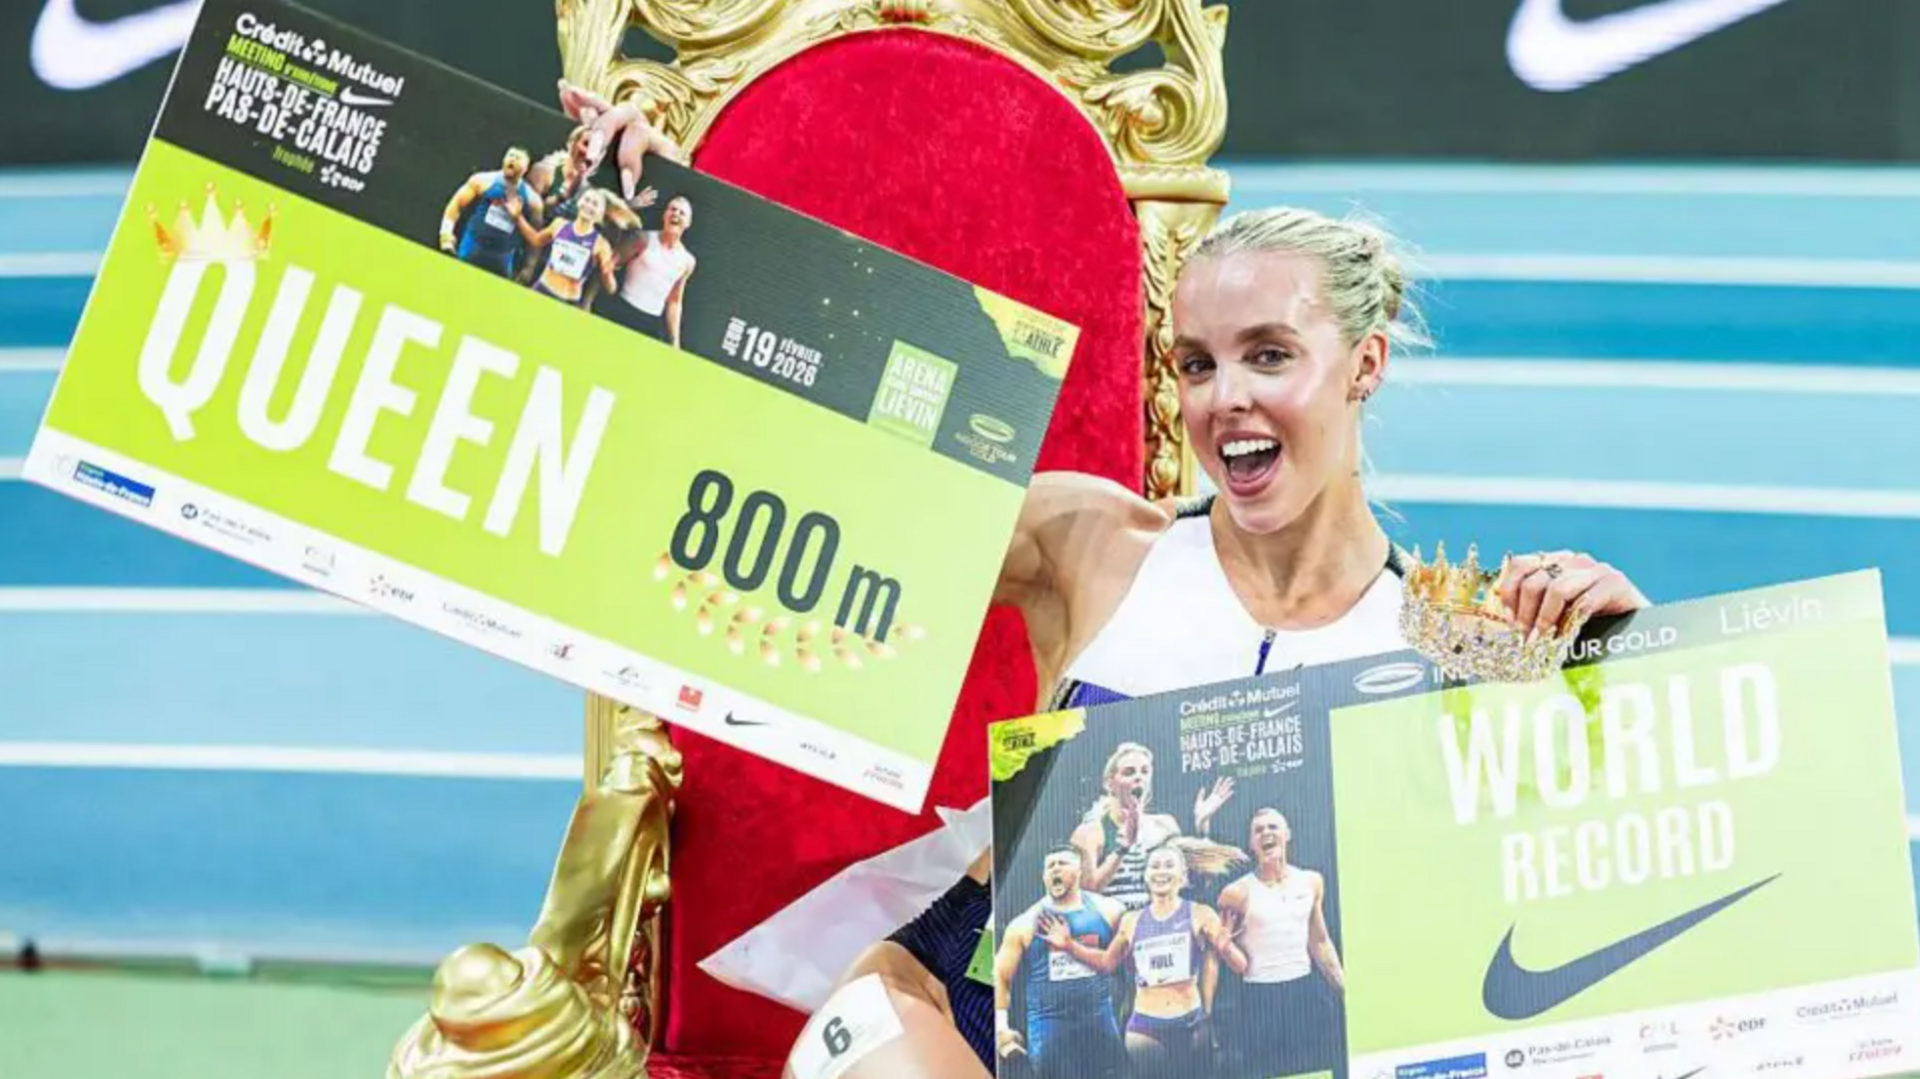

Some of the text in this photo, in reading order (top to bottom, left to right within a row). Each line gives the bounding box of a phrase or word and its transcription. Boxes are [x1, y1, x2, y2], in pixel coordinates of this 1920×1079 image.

[226, 33, 287, 72] MEETING
[236, 13, 305, 58] Crédit
[327, 49, 404, 97] Mutuel
[214, 56, 387, 147] HAUTS-DE-FRANCE
[204, 82, 378, 175] PAS-DE-CALAIS
[743, 326, 777, 368] 19
[771, 352, 818, 388] 2026
[885, 354, 946, 394] ARENA
[137, 256, 617, 558] QUEEN
[670, 469, 901, 644] 800 m
[1720, 596, 1823, 635] Liévin
[1606, 626, 1677, 654] GOLD
[1180, 682, 1300, 716] Crédit Mutuel
[1180, 714, 1303, 752] HAUTS-DE-FRANCE
[1182, 733, 1304, 774] PAS-DE-CALAIS
[1438, 662, 1782, 826] WORLD
[1501, 800, 1735, 902] RECORD
[822, 1016, 852, 1058] 6
